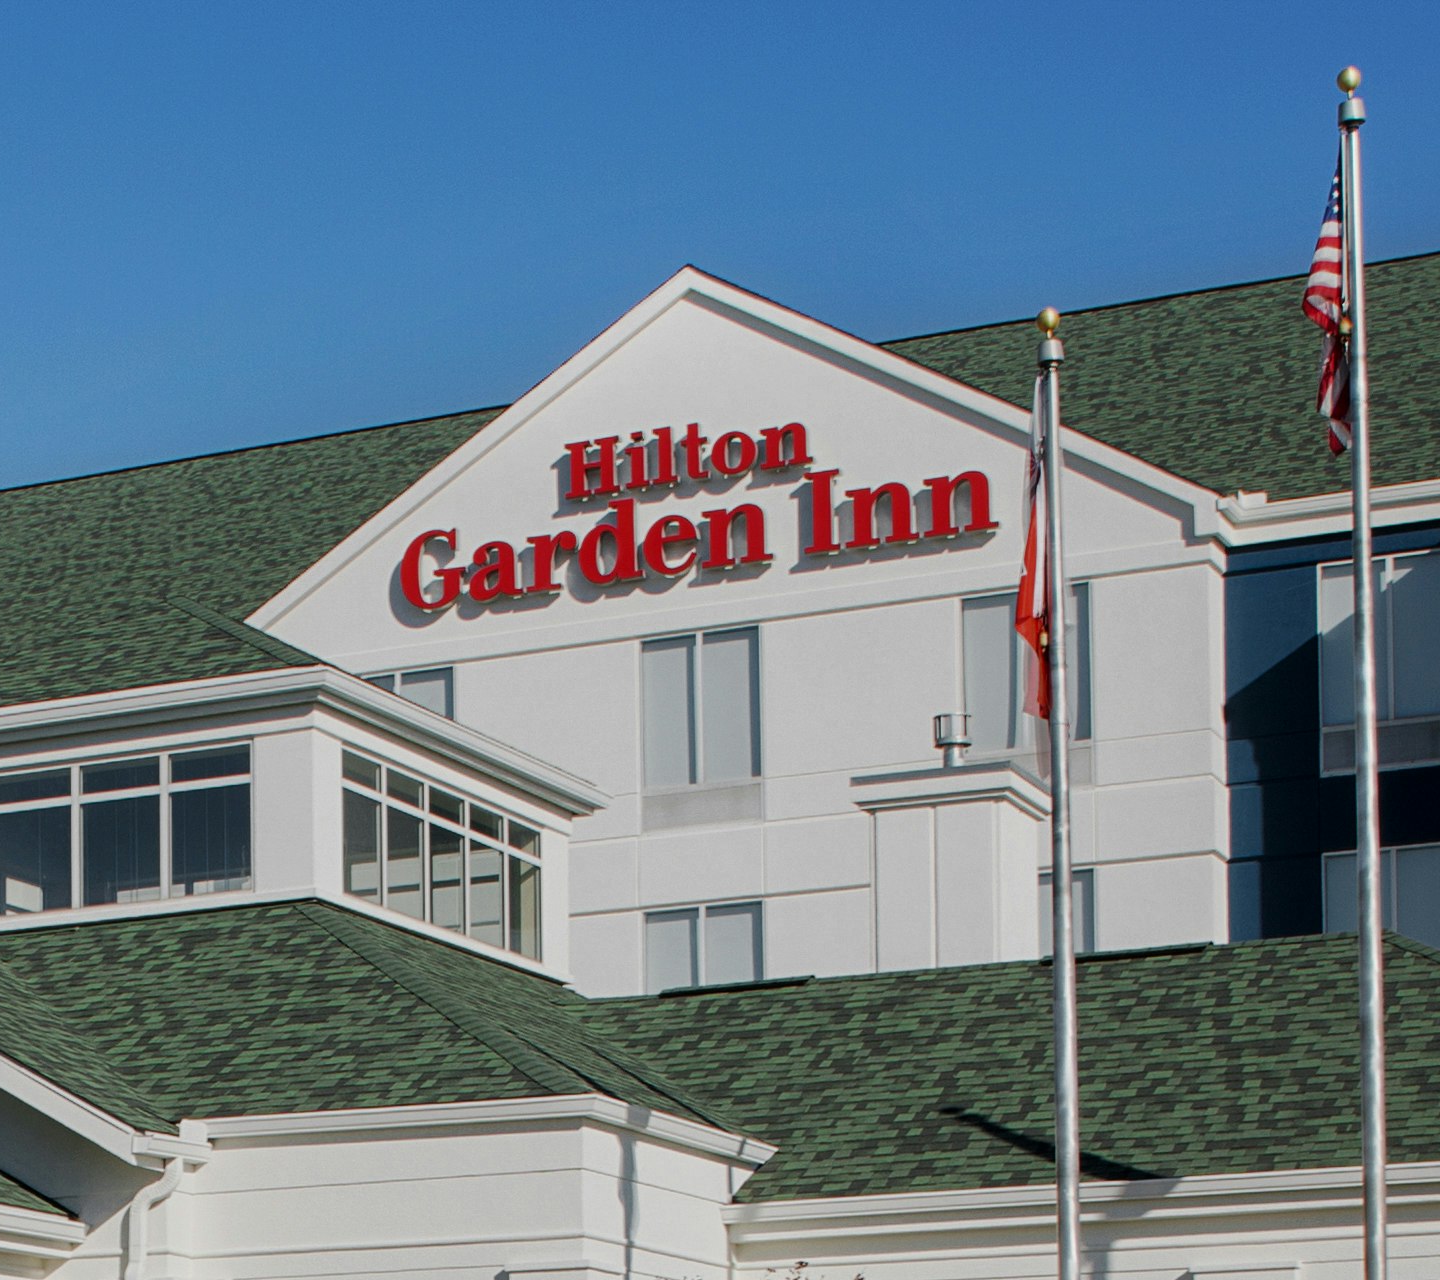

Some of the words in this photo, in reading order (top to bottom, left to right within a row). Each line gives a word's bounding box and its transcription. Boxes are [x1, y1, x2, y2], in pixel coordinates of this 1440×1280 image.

[564, 422, 814, 500] Hilton
[400, 498, 774, 611] Garden
[803, 468, 1000, 555] Inn
